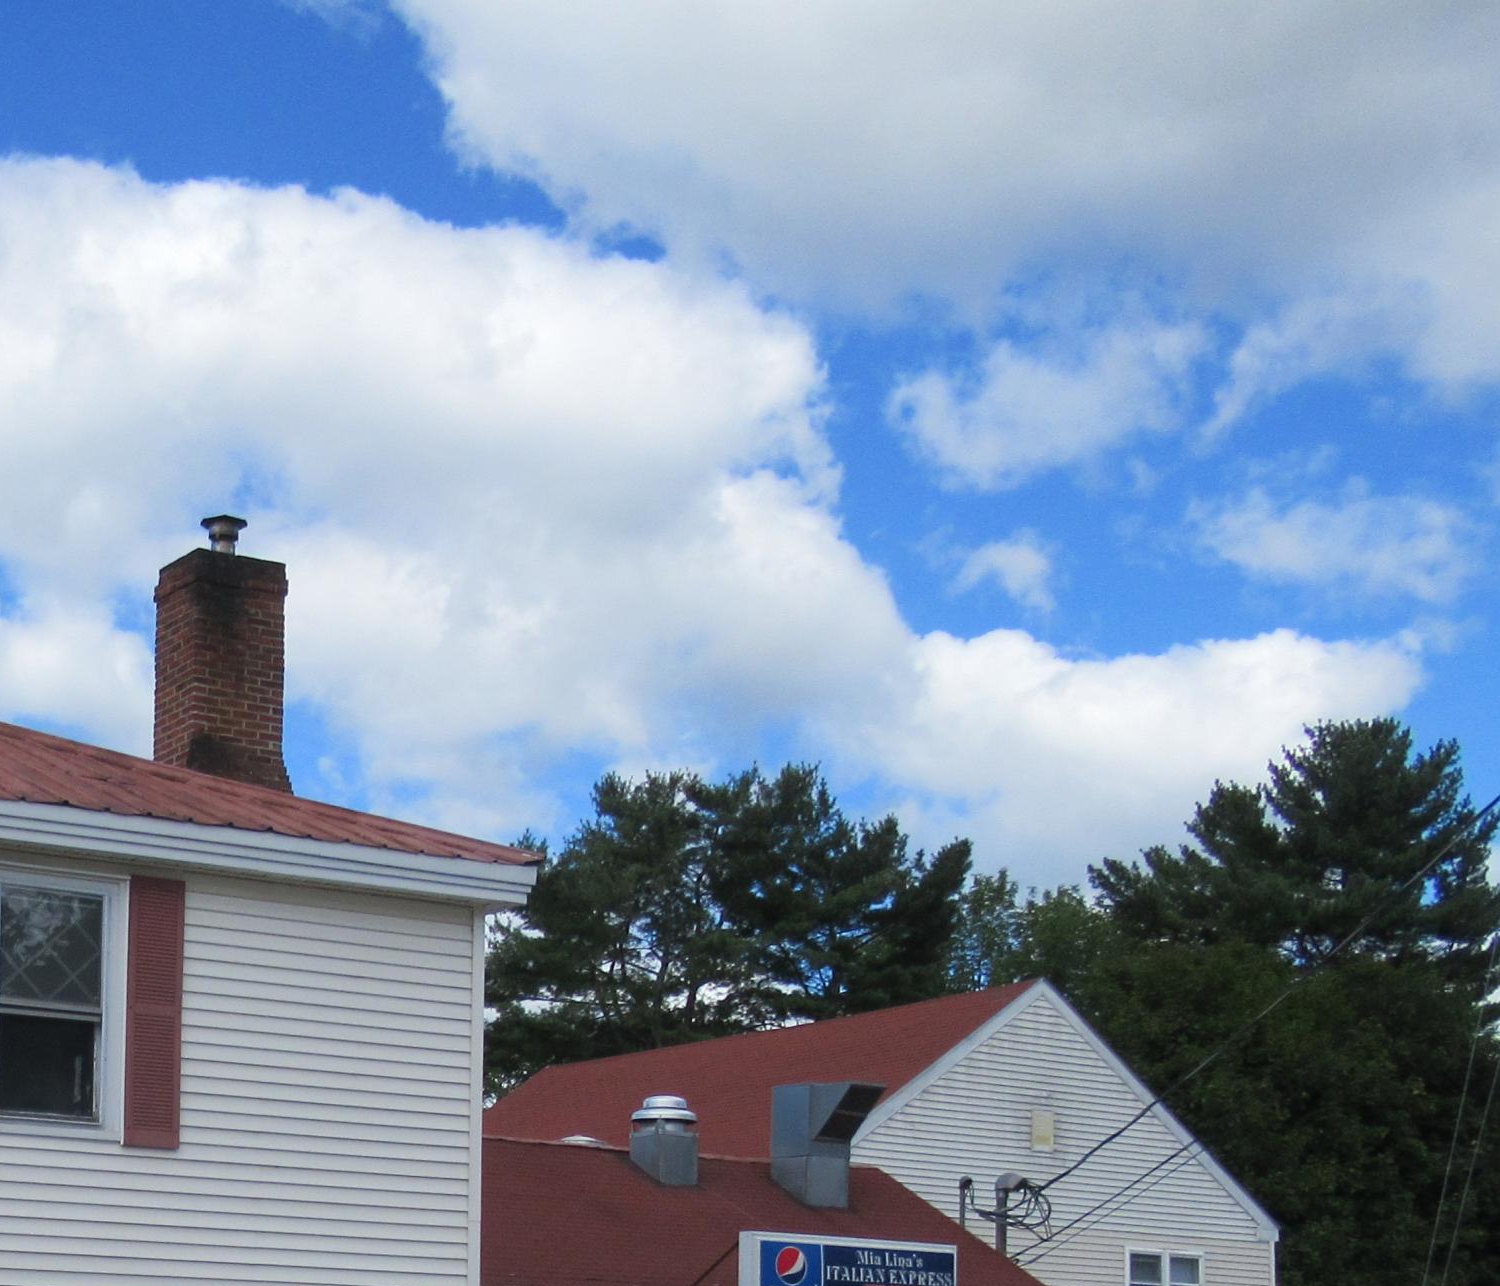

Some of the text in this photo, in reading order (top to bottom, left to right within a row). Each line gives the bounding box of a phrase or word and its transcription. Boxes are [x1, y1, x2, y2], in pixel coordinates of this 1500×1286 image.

[855, 1249, 924, 1270] Mia Lina's
[825, 1265, 885, 1283] ITALIAN
